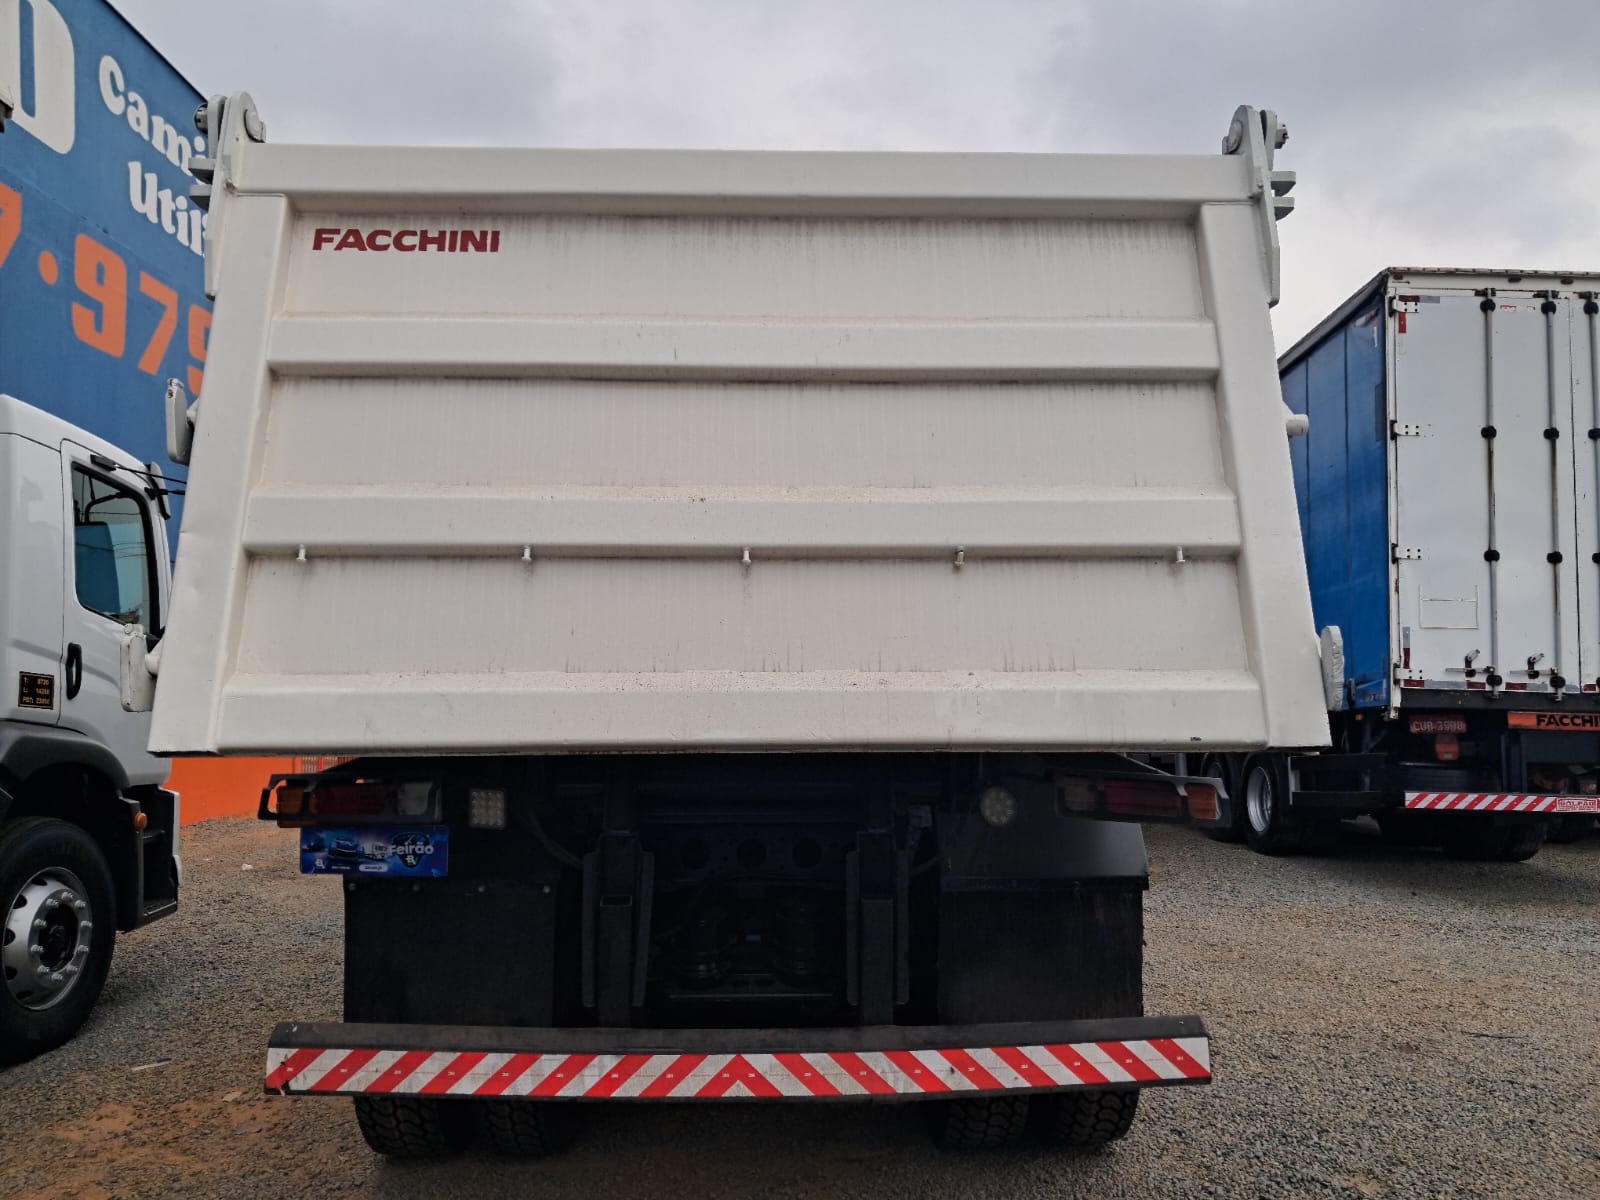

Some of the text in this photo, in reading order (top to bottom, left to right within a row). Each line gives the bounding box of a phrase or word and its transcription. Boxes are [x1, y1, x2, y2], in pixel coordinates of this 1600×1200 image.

[128, 160, 208, 257] Util
[312, 228, 500, 253] FACCHINI
[1536, 713, 1600, 728] FACCHI
